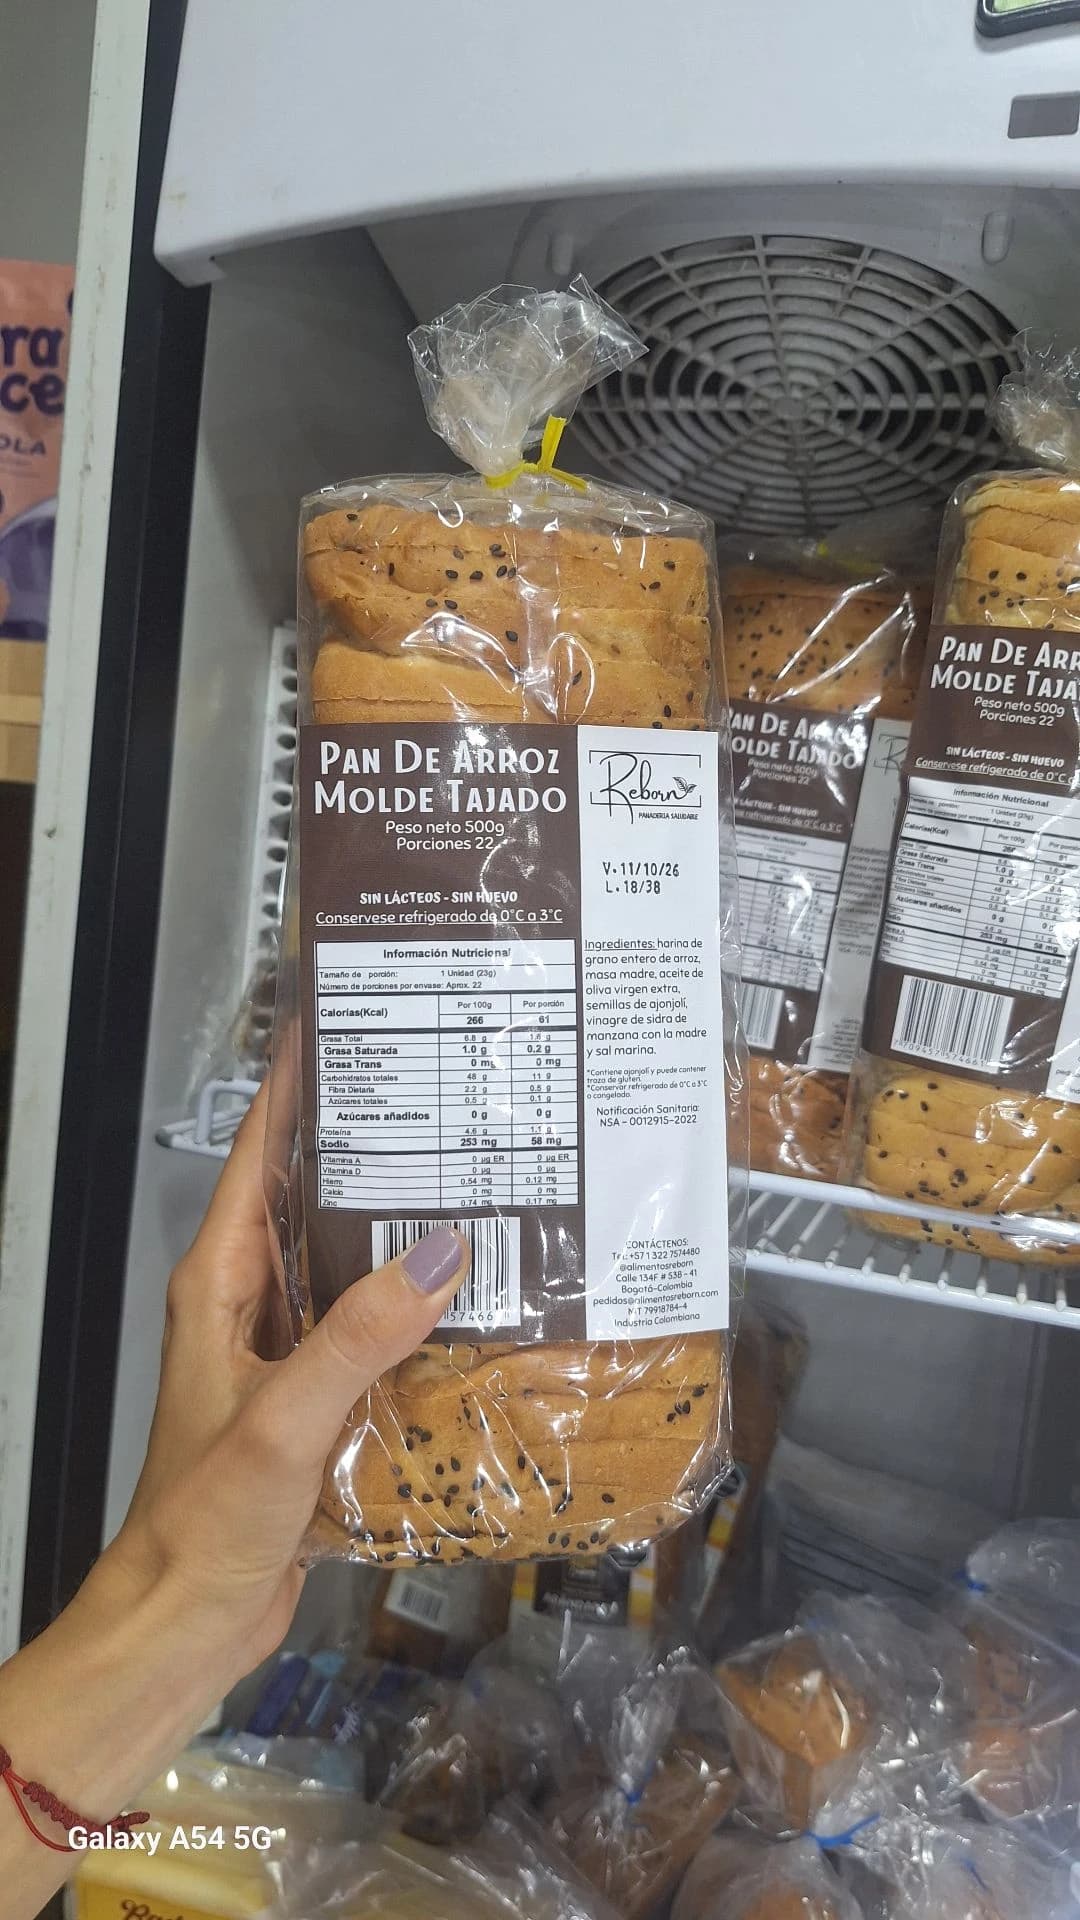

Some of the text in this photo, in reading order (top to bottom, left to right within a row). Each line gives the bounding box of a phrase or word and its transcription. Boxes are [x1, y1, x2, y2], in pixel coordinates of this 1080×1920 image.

[939, 636, 983, 662] PAN
[990, 638, 1028, 666] DE
[930, 664, 1080, 701] MOLDE TAJA
[974, 696, 1065, 718] Peso neto 500g
[979, 709, 1055, 727] Porciones 22
[320, 739, 560, 775] PAN DE ARROZ
[1030, 755, 1065, 768] HUEVO
[968, 764, 1028, 779] refrigerado
[1029, 771, 1044, 781] de
[600, 753, 688, 824] Reborn
[314, 779, 567, 814] MOLDE TAJADO
[385, 820, 504, 836] Peso neto 500g
[396, 837, 494, 850] Porciones 22
[360, 890, 518, 904] SIN LÁCTEOS SIN HUEVO
[316, 912, 396, 925] Conservese
[399, 909, 478, 925] refrigerado
[480, 909, 497, 923] de
[528, 912, 537, 922] a
[584, 938, 703, 951] Ingredientes: harina de
[383, 948, 511, 960] Información Nutricional
[585, 953, 701, 967] grano entero de arroz,
[319, 971, 350, 979] Tamaño
[368, 971, 398, 980] porción:
[447, 969, 497, 978] Unidad (23g)
[585, 968, 704, 980] masa madre, aceite de
[319, 983, 349, 991] Número
[362, 983, 398, 992] porciones
[400, 983, 412, 992] por
[472, 981, 482, 989] 22
[586, 984, 681, 997] oliva virgen extra,
[457, 1001, 493, 1010] Por 100g
[523, 1000, 565, 1009] Por porción
[586, 999, 631, 1010] semillas
[633, 999, 647, 1009] de
[466, 1016, 484, 1025] 266
[586, 1012, 687, 1027] vinagre de sidra de
[345, 1035, 363, 1043] Total
[586, 1027, 707, 1041] manzana con la madre
[324, 1046, 398, 1055] Grasa Saturada
[586, 1045, 657, 1059] y sal marina.
[324, 1060, 382, 1068] Grasa Trans
[656, 1066, 678, 1076] puede
[628, 1082, 668, 1092] refrigerado
[336, 1111, 430, 1121] Azúcares añadidos
[596, 1104, 654, 1117] Notificación
[600, 1117, 620, 1128] NSA
[320, 1140, 349, 1148] Sodio
[460, 1138, 497, 1147] 253 mg
[531, 1136, 562, 1146] 58 mg
[630, 1251, 644, 1260] +57
[652, 1250, 668, 1259] 322
[615, 1273, 637, 1283] Calle
[614, 1312, 700, 1328] Industria Colombiana
